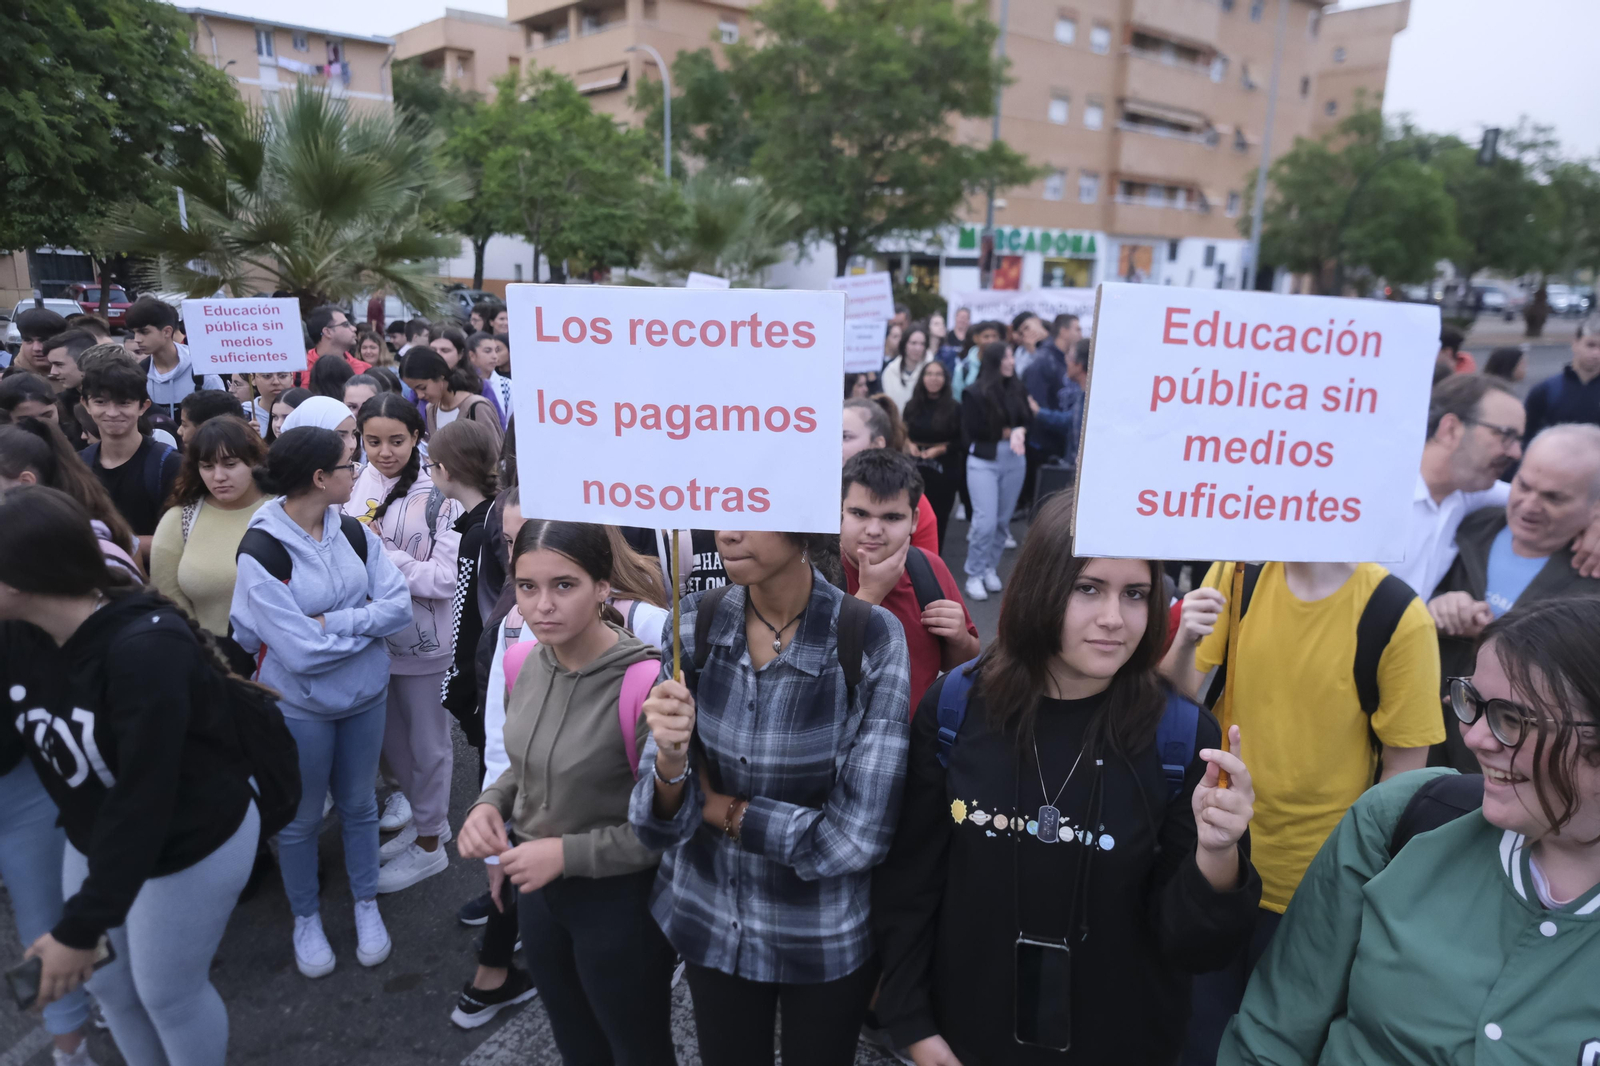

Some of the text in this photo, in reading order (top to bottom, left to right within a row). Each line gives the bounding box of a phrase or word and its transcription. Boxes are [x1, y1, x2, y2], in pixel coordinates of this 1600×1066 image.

[959, 227, 1096, 254] MRCADONA
[204, 304, 280, 316] Educación
[205, 320, 283, 334] pública sin
[536, 307, 815, 348] Los recortes
[221, 336, 273, 347] medios
[1163, 307, 1382, 357] Educación
[211, 352, 287, 363] suficientes
[1150, 367, 1377, 413] pública sin
[537, 389, 817, 440] los pagamos
[1184, 430, 1334, 467] medios
[583, 478, 770, 512] nosotras
[1137, 482, 1361, 522] suficientes
